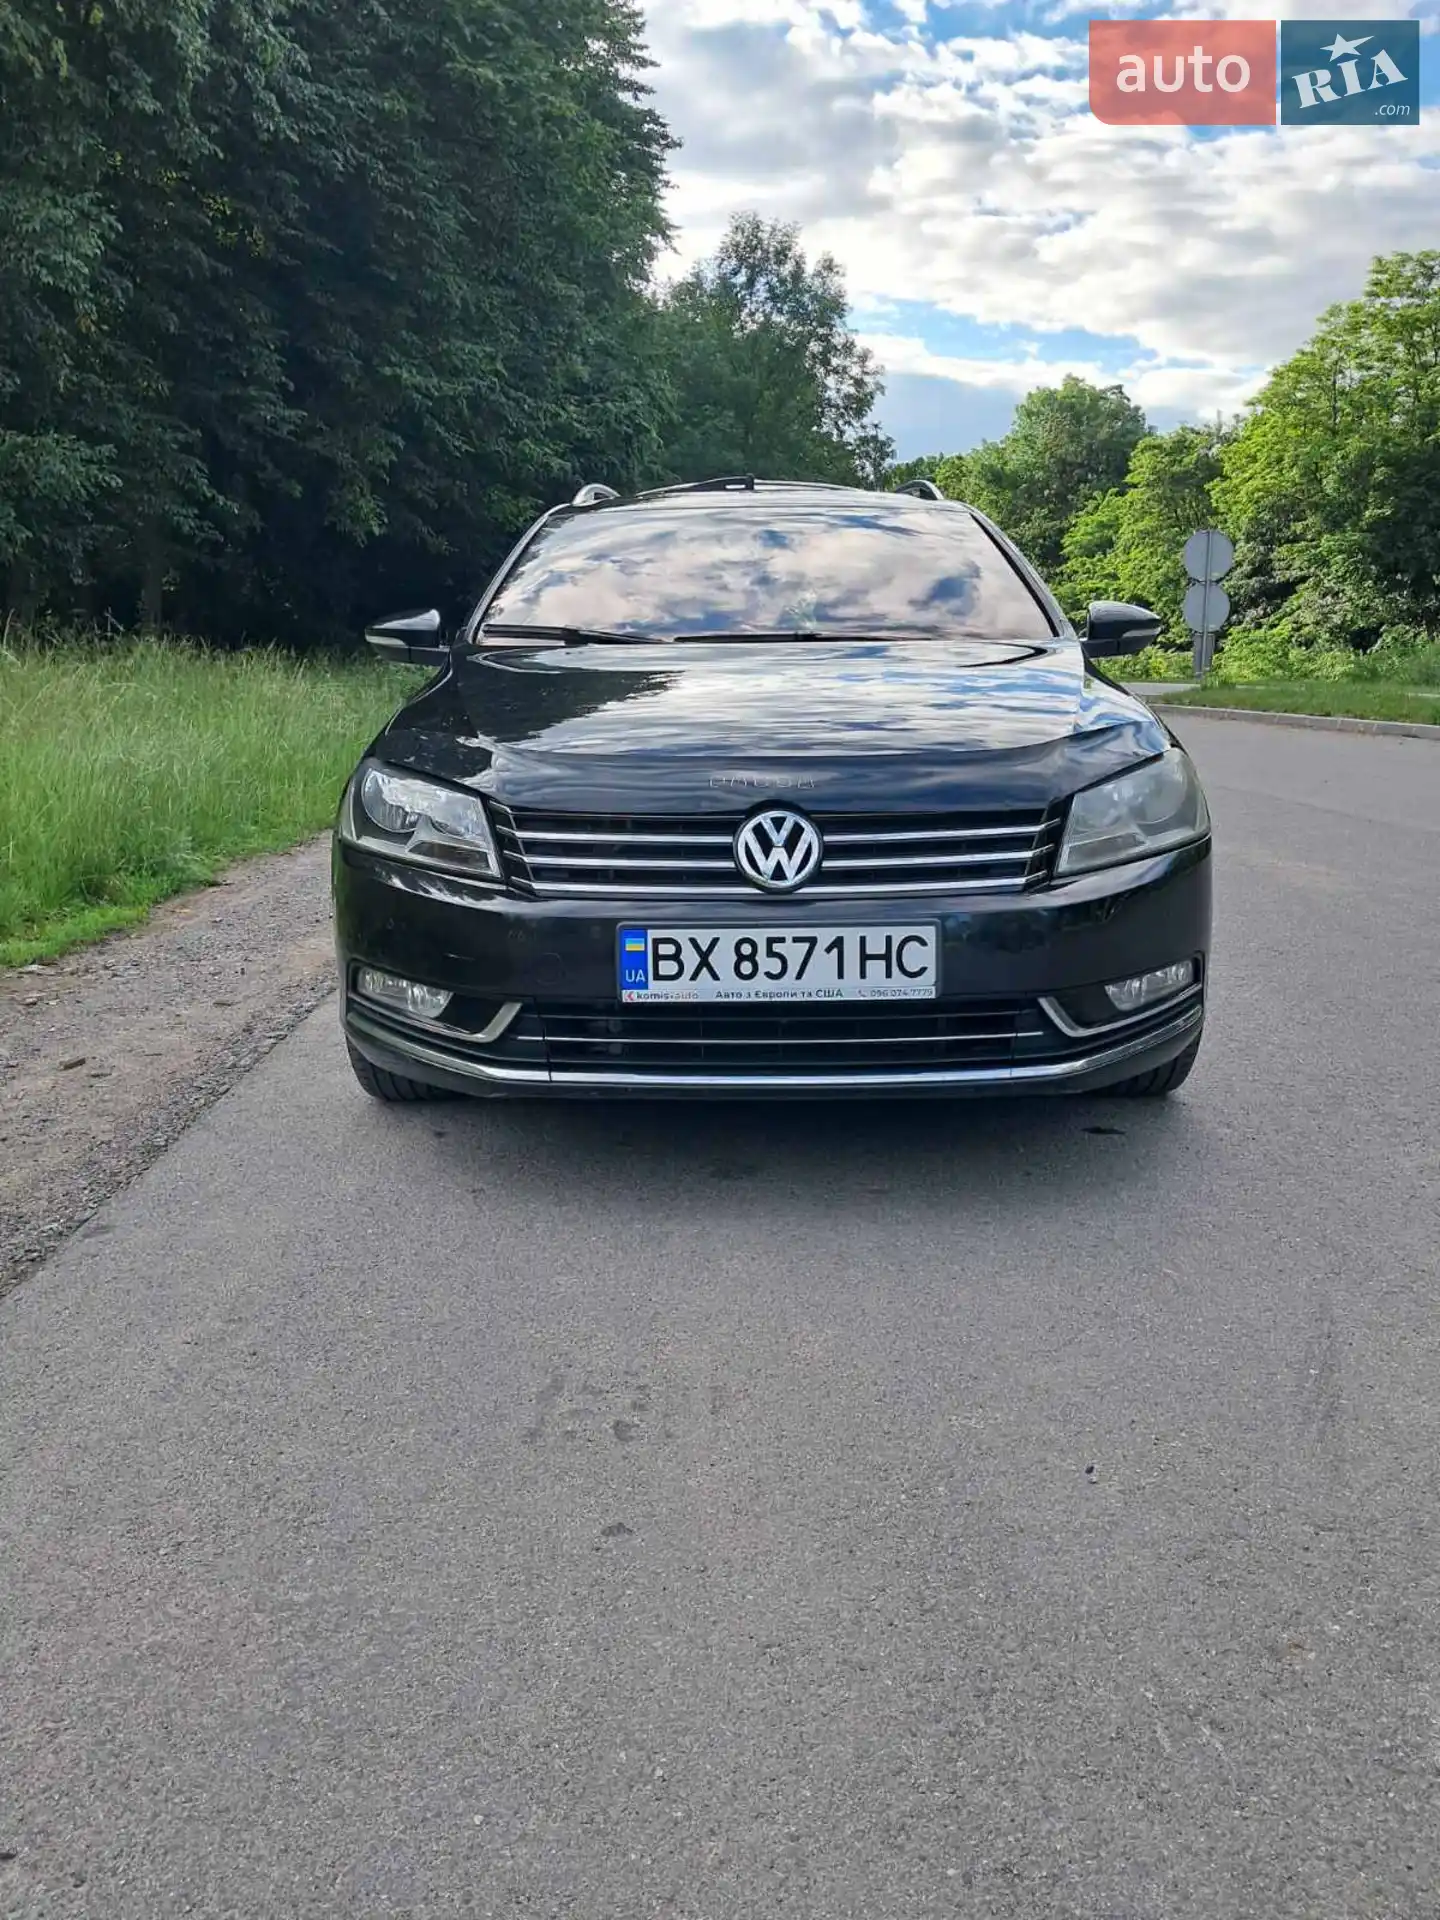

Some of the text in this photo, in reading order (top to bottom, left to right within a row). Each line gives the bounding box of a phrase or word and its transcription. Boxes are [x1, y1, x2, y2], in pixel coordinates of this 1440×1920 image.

[652, 937, 721, 982] BX
[625, 969, 646, 983] UA
[715, 990, 743, 999] Авто
[754, 989, 798, 1000] Європи
[815, 988, 844, 998] США
